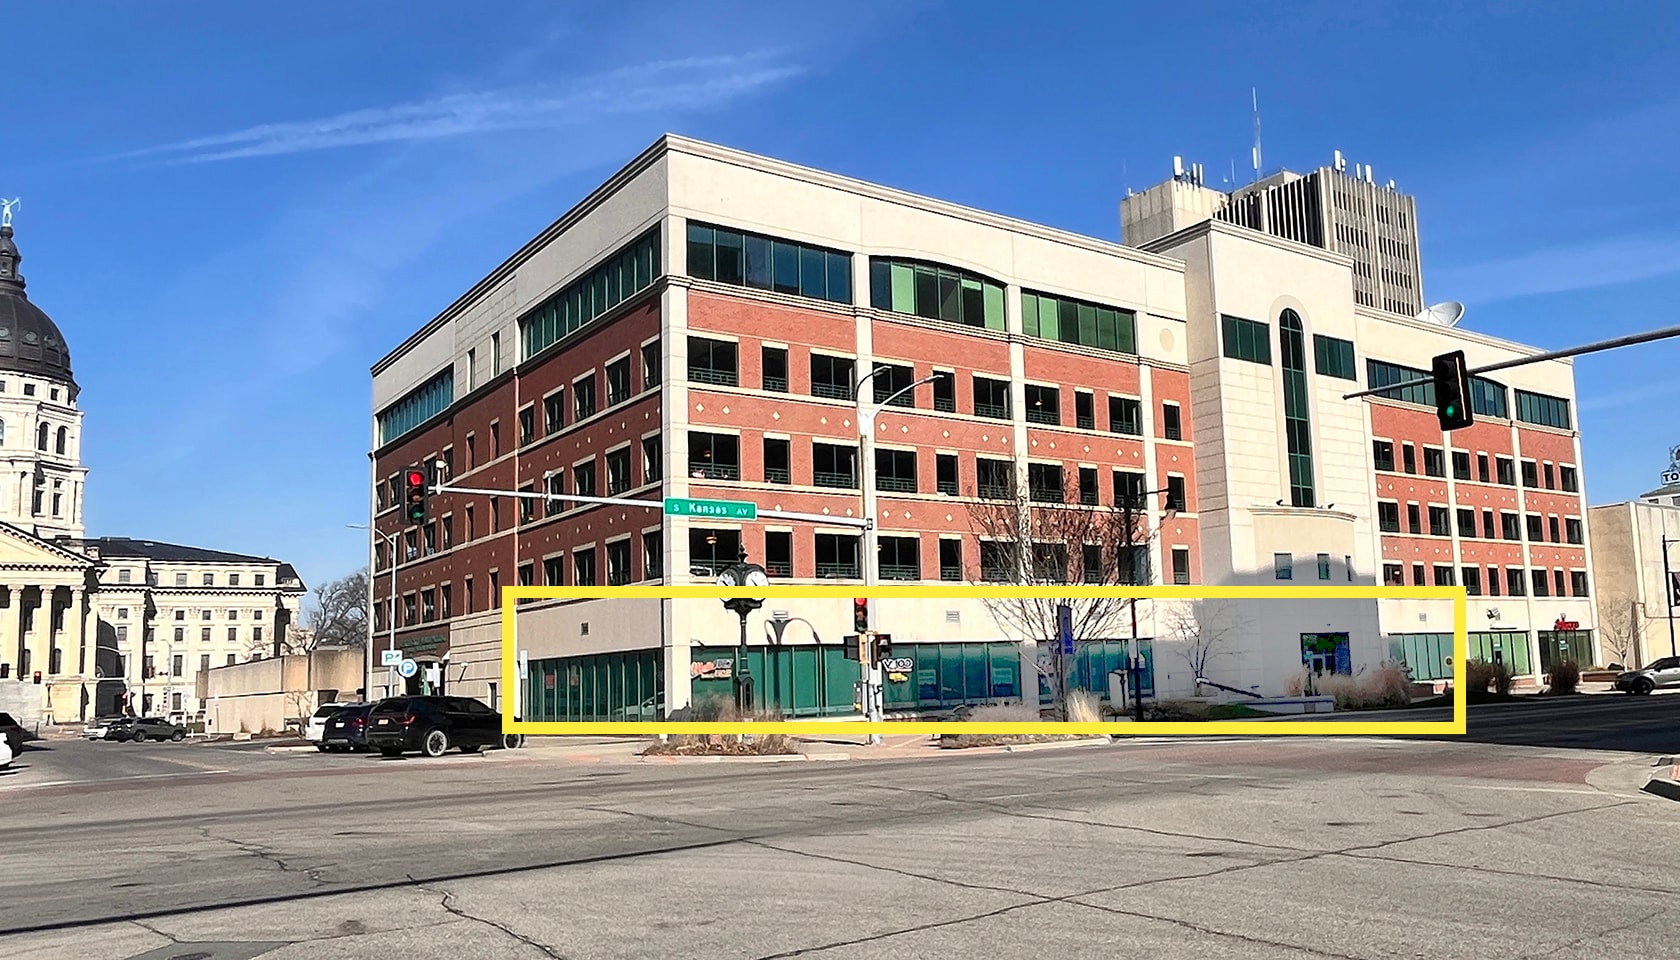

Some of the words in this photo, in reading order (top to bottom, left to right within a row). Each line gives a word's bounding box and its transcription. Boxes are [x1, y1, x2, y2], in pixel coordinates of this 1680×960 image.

[1663, 472, 1680, 482] TO
[673, 503, 680, 512] S
[688, 503, 728, 515] Kansas
